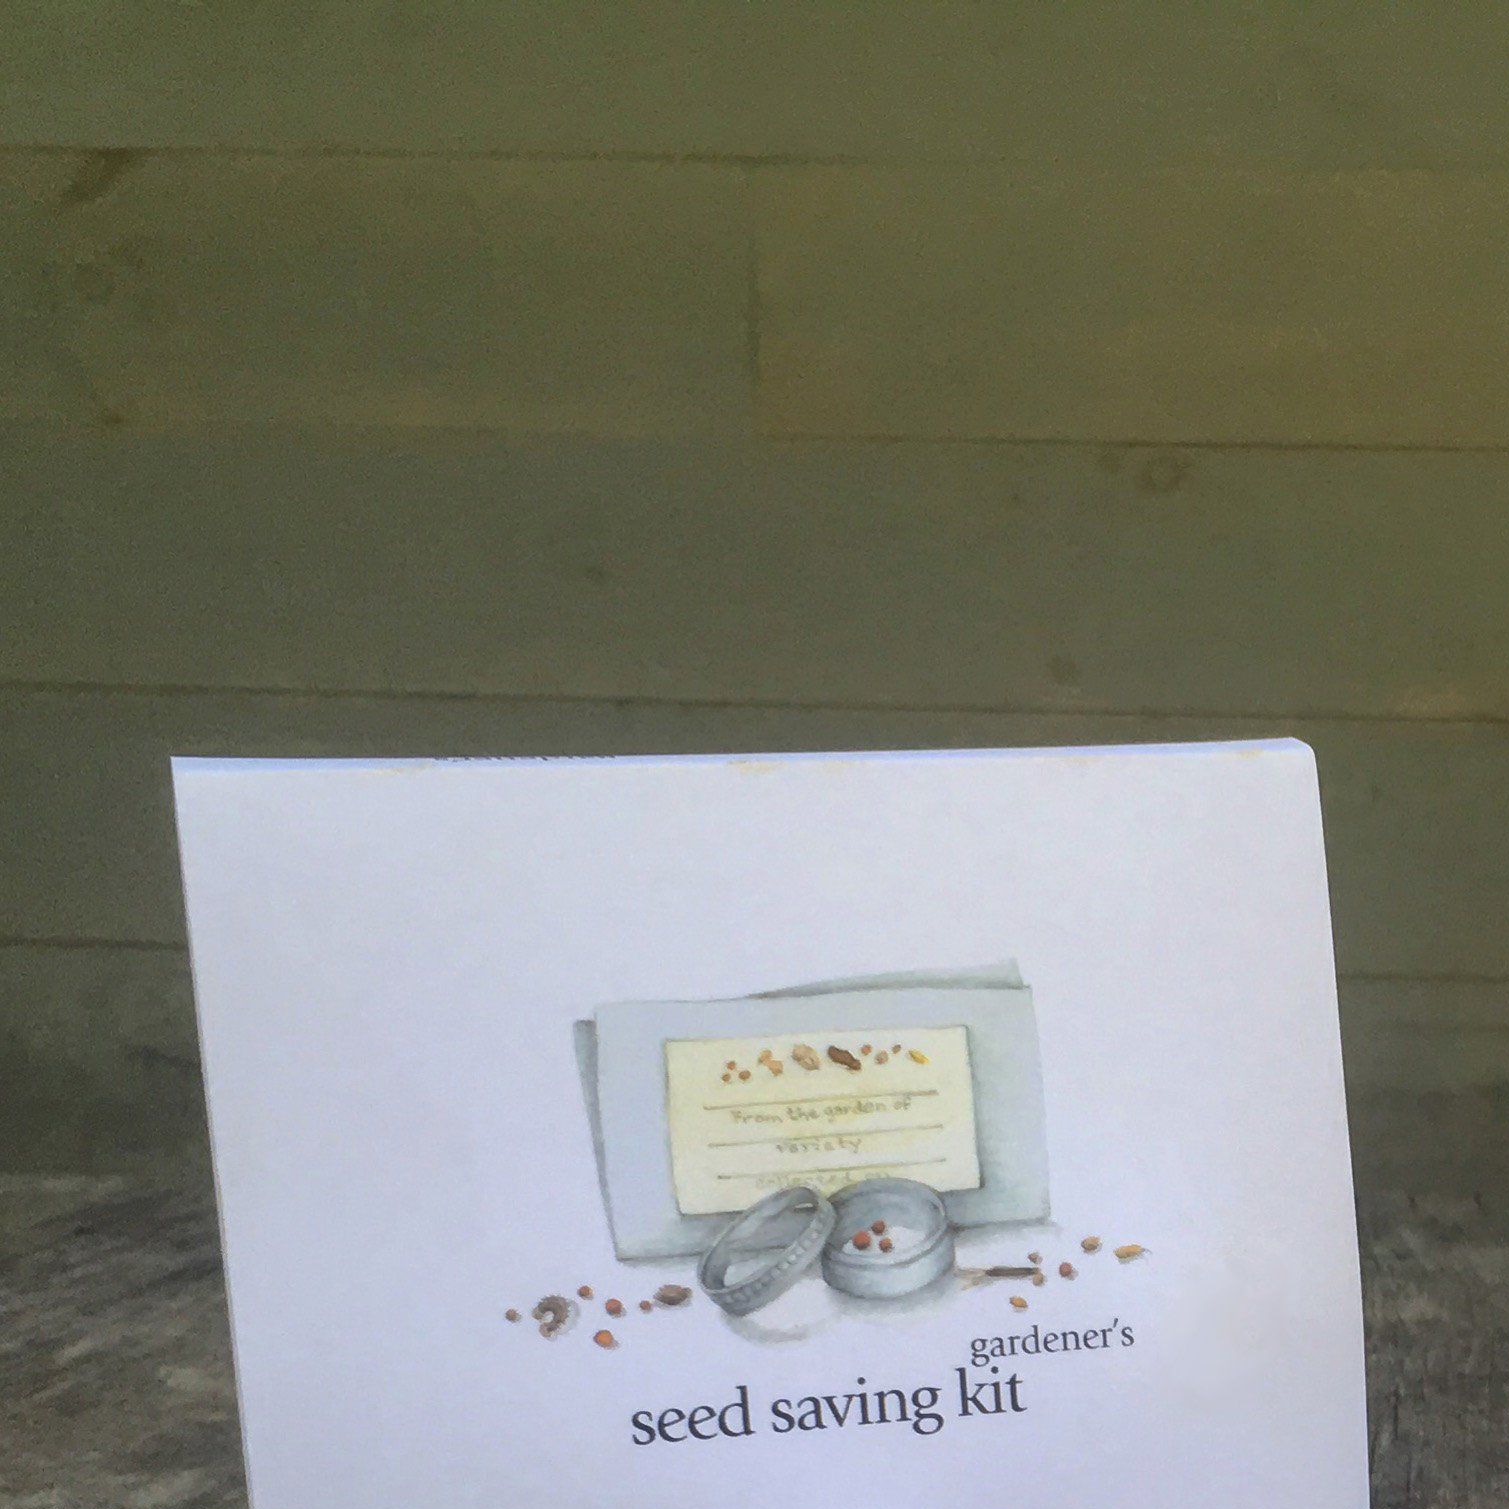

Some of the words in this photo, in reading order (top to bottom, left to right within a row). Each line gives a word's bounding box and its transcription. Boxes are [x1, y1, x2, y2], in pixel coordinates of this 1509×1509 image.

[970, 1318, 1135, 1366] gardener's
[631, 1385, 753, 1445] seed
[771, 1377, 943, 1436] saving
[958, 1365, 1027, 1420] kit
